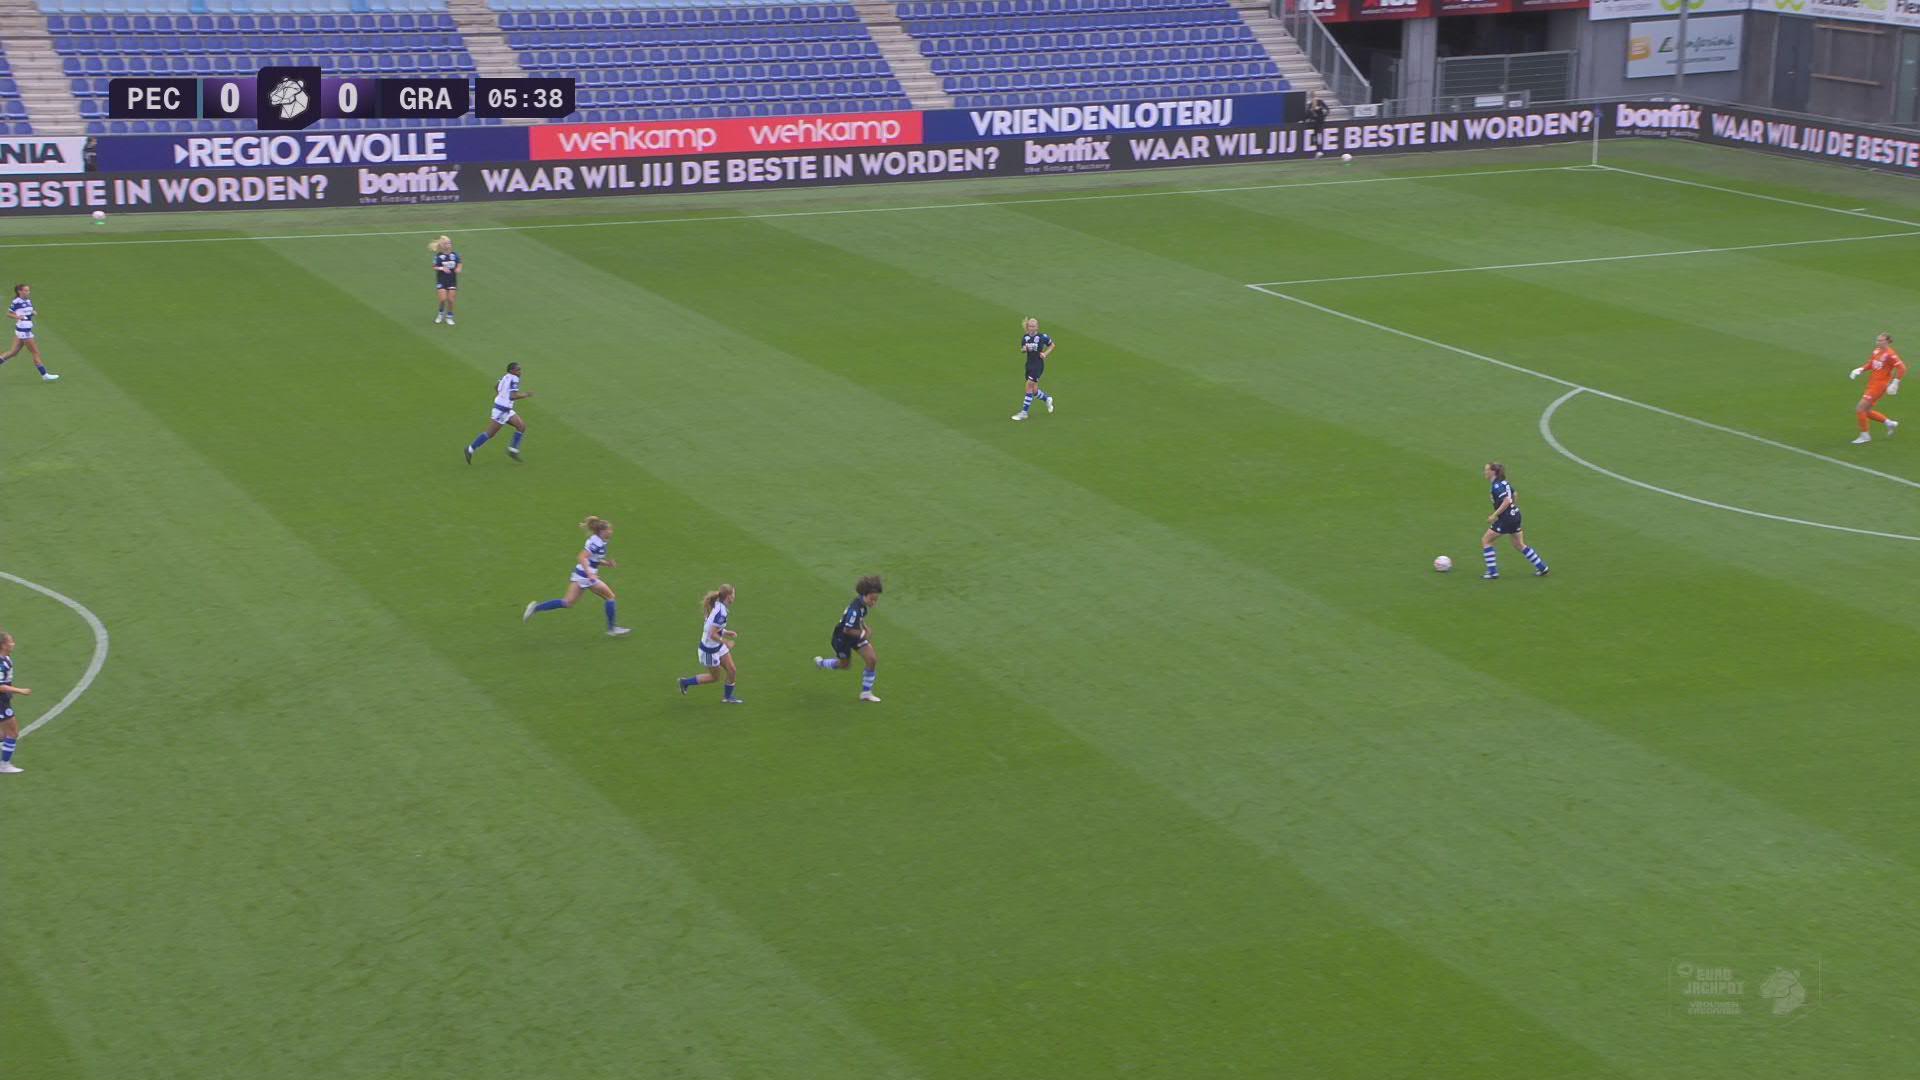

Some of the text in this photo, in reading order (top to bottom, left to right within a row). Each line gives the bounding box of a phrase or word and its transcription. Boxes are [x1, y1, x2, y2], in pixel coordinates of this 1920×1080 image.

[749, 119, 901, 144] wehkamp
[970, 99, 1233, 136] VRIENDENLOTERIJ
[1616, 104, 1701, 129] bonfix
[188, 132, 447, 168] REGIO ZWOLLE
[558, 127, 717, 152] wehkamp
[1025, 137, 1110, 164] bonfix
[1130, 136, 1210, 161] WAAR
[1216, 132, 1262, 156] WIL
[1267, 130, 1297, 154] JIJ
[1344, 122, 1426, 149] BESTE
[1430, 120, 1458, 144] IN
[1464, 110, 1593, 140] WORDEN?
[1712, 113, 1920, 167] WAAR WIL JIJ DE BESTE
[358, 166, 459, 194] bonfix
[481, 146, 999, 193] WAAR WIL JIJ DE BESTE IN WORDEN?
[0, 174, 328, 208] BESTE IN WORDEN?
